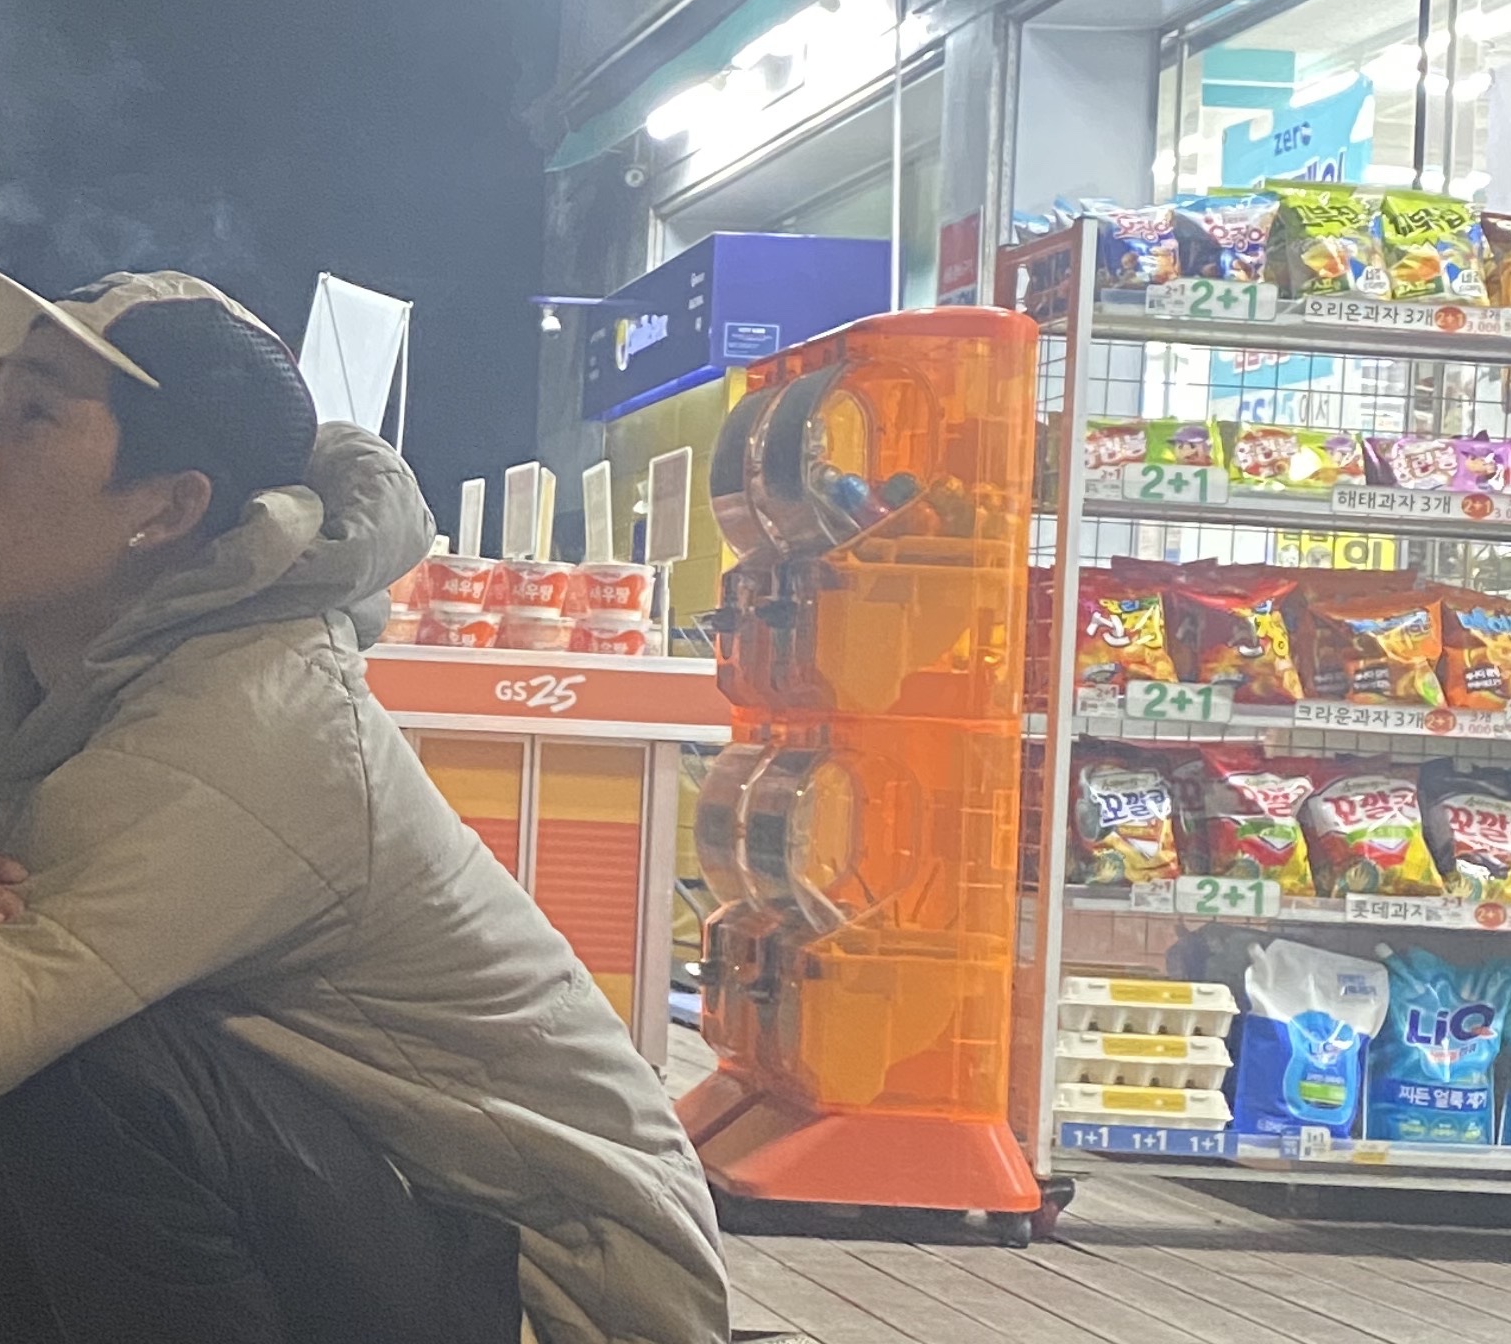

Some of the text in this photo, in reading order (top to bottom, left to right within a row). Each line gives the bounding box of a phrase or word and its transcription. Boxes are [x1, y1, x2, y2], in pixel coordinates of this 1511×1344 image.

[1273, 120, 1313, 157] zero
[1189, 279, 1258, 321] 2+1
[1310, 301, 1434, 327] 오리온과자 3개
[1436, 311, 1464, 327] 2+1
[1140, 464, 1209, 502] 2+1
[1337, 489, 1452, 514] 해태과자 3개
[1462, 498, 1491, 515] 2+1
[495, 674, 587, 713] GS25
[1143, 682, 1213, 721] 2+1
[1295, 704, 1425, 729] 크라운과자 3개
[1426, 713, 1455, 729] 2+1
[1098, 789, 1172, 825] 꼬깔콘
[1323, 787, 1420, 827] 꼬깔콘
[1196, 878, 1265, 915] 2+1
[1476, 905, 1505, 923] 2+1
[1407, 1003, 1497, 1047] LiQ
[1399, 1084, 1431, 1106] 찌든
[1433, 1089, 1464, 1110] 얼룩
[1073, 1126, 1226, 1153] 1+1 1+1 1+1
